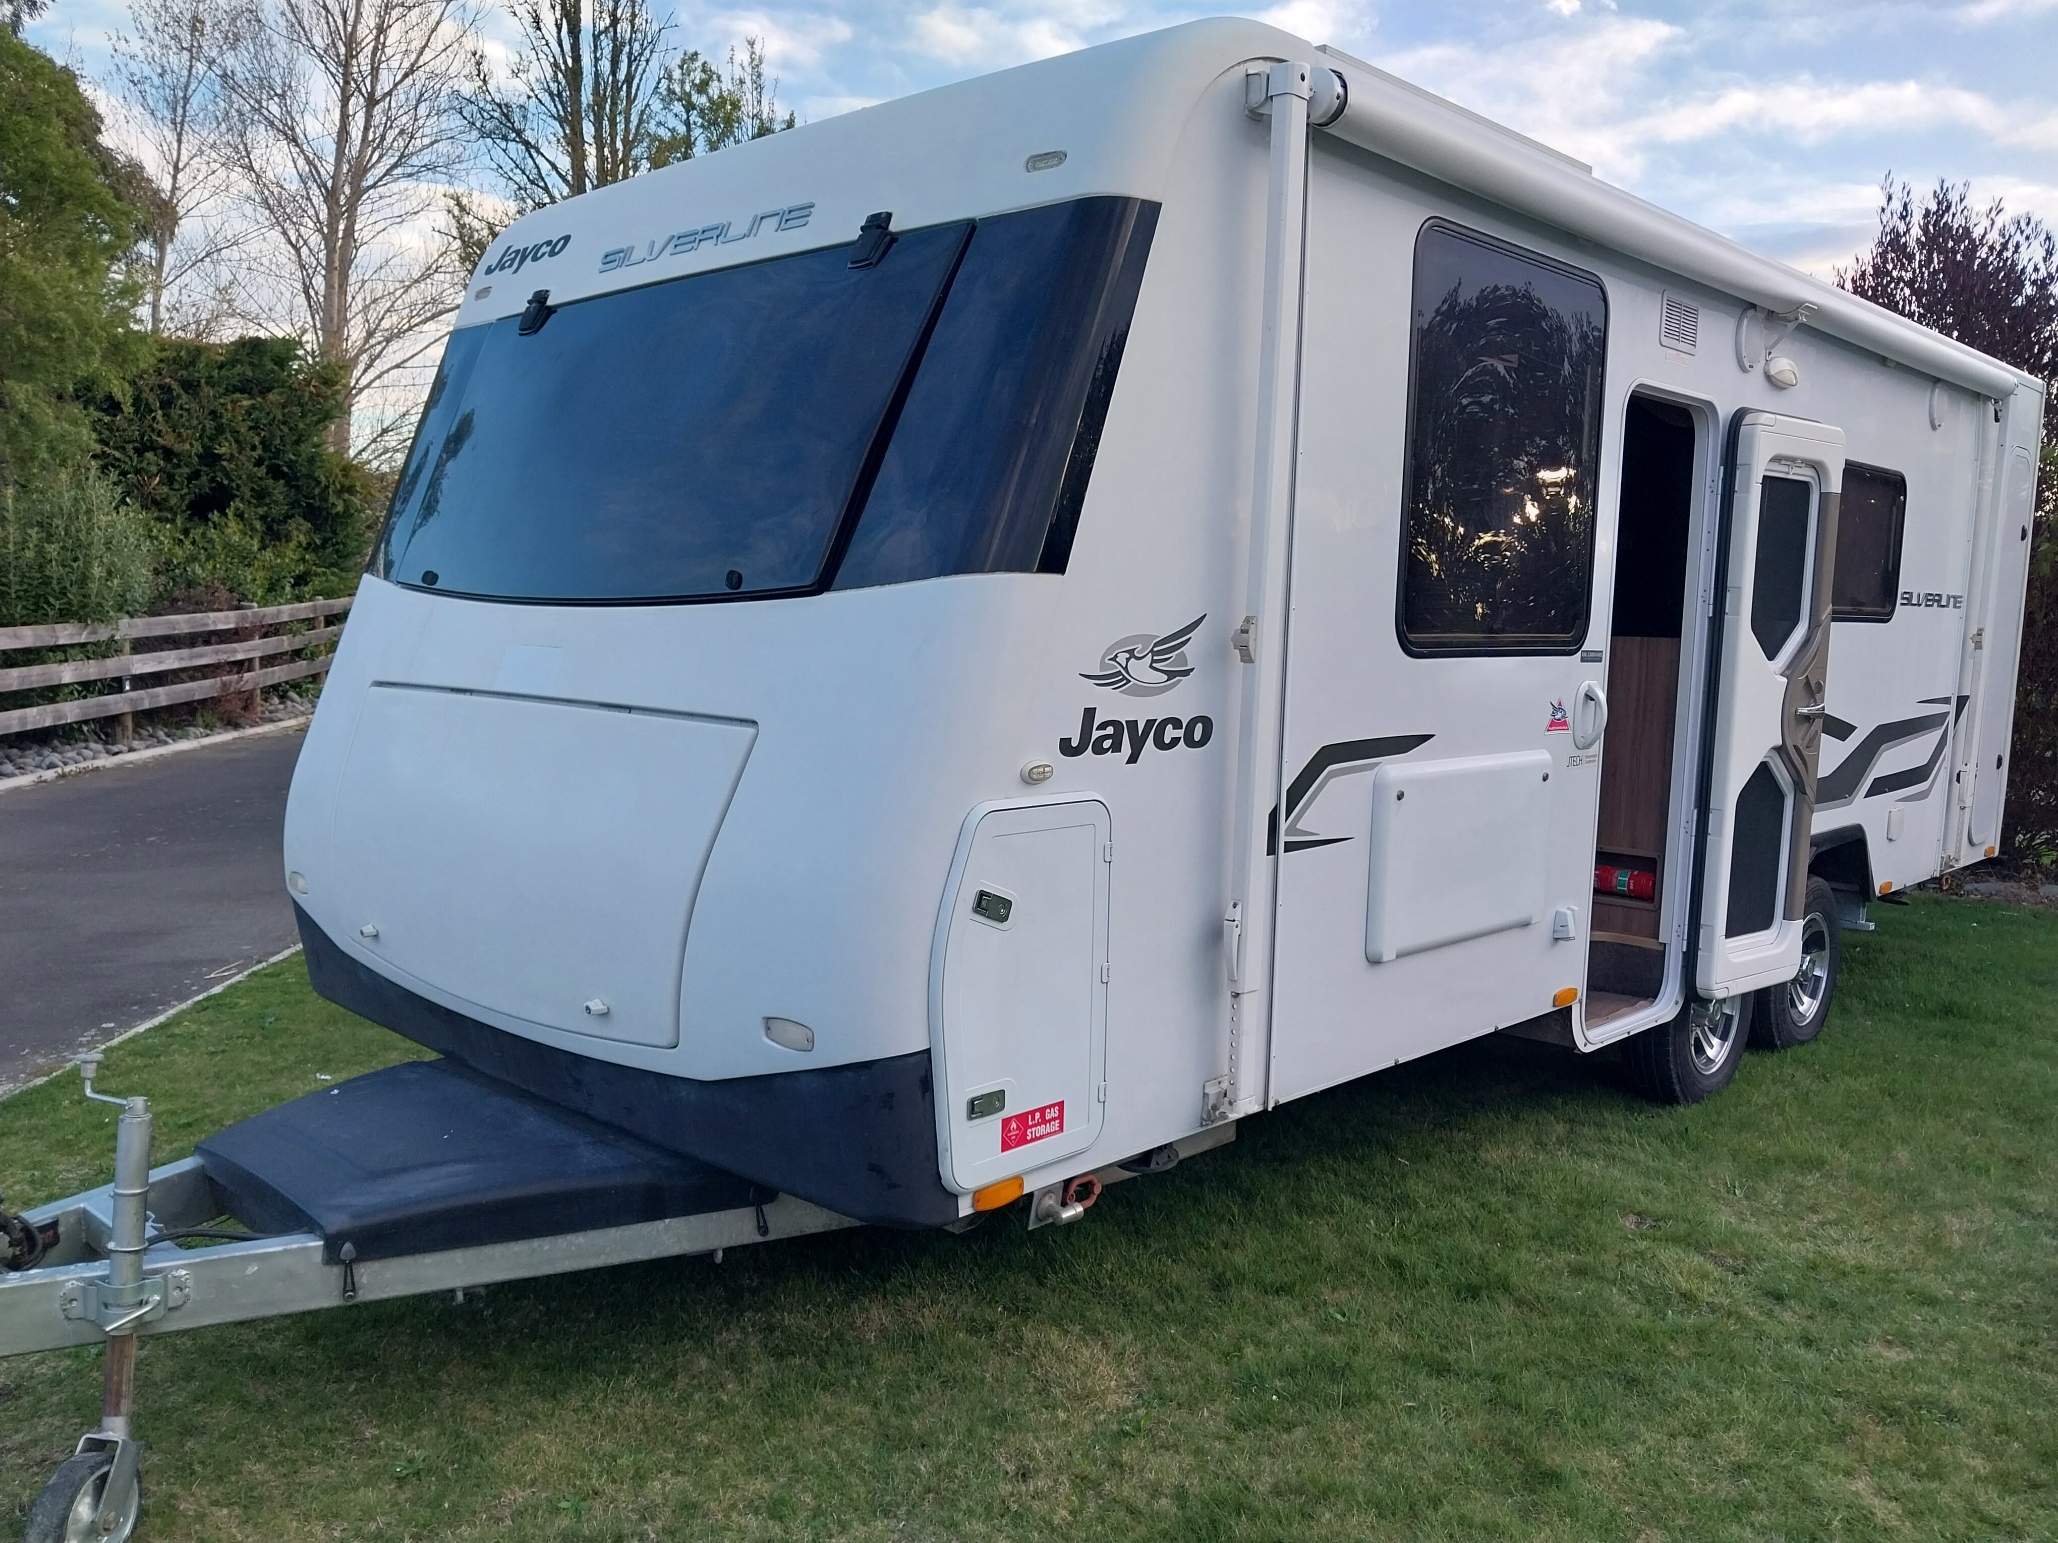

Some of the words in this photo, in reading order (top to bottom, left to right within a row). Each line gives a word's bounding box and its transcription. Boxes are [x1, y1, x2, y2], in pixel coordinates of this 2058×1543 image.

[484, 234, 572, 275] Jayco
[598, 201, 816, 273] SILVERLINE
[1058, 706, 1214, 765] Jayco
[1026, 1119, 1060, 1140] STORAGE
[1028, 1112, 1041, 1125] L.P.
[1045, 1106, 1059, 1120] GAS
